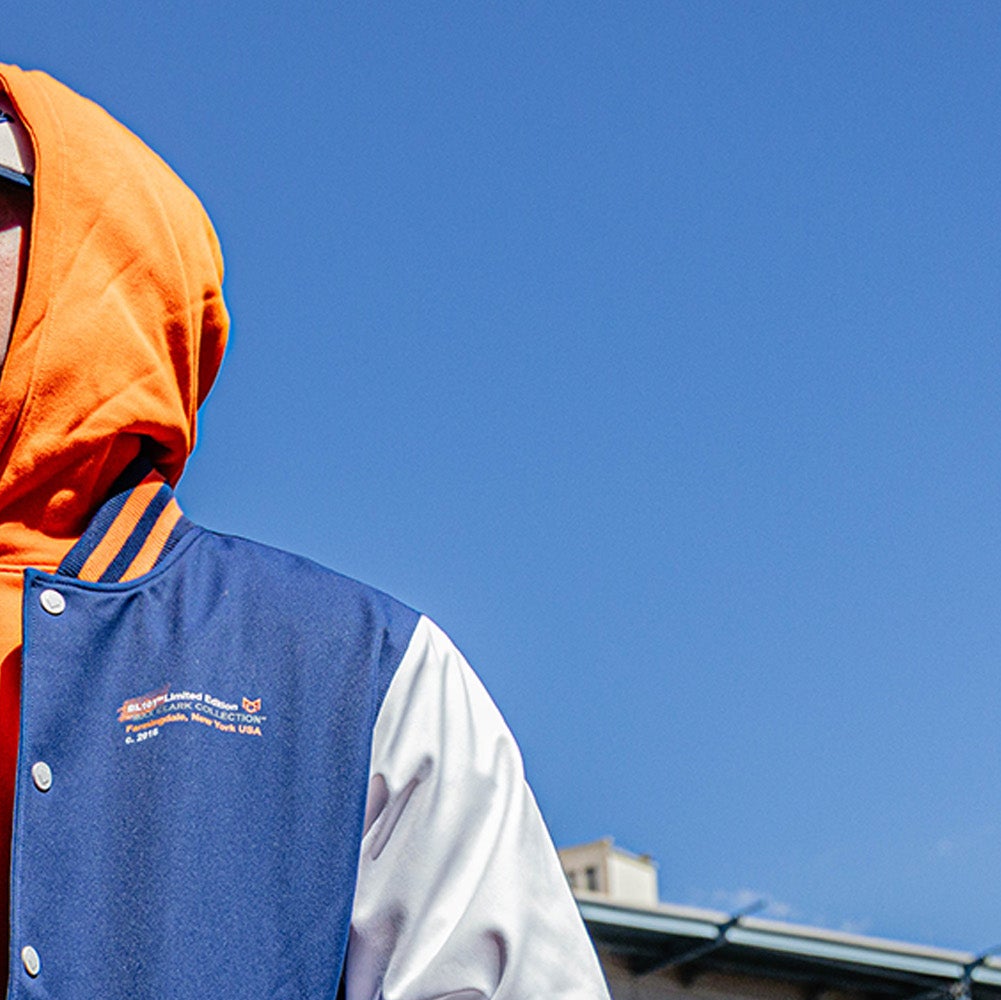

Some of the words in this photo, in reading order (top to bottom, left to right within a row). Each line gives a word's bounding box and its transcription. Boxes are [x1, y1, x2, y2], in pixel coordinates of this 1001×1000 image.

[164, 691, 203, 703] Limited
[204, 694, 239, 711] Edition
[191, 712, 213, 726] New
[213, 719, 236, 733] York
[238, 724, 262, 736] USA
